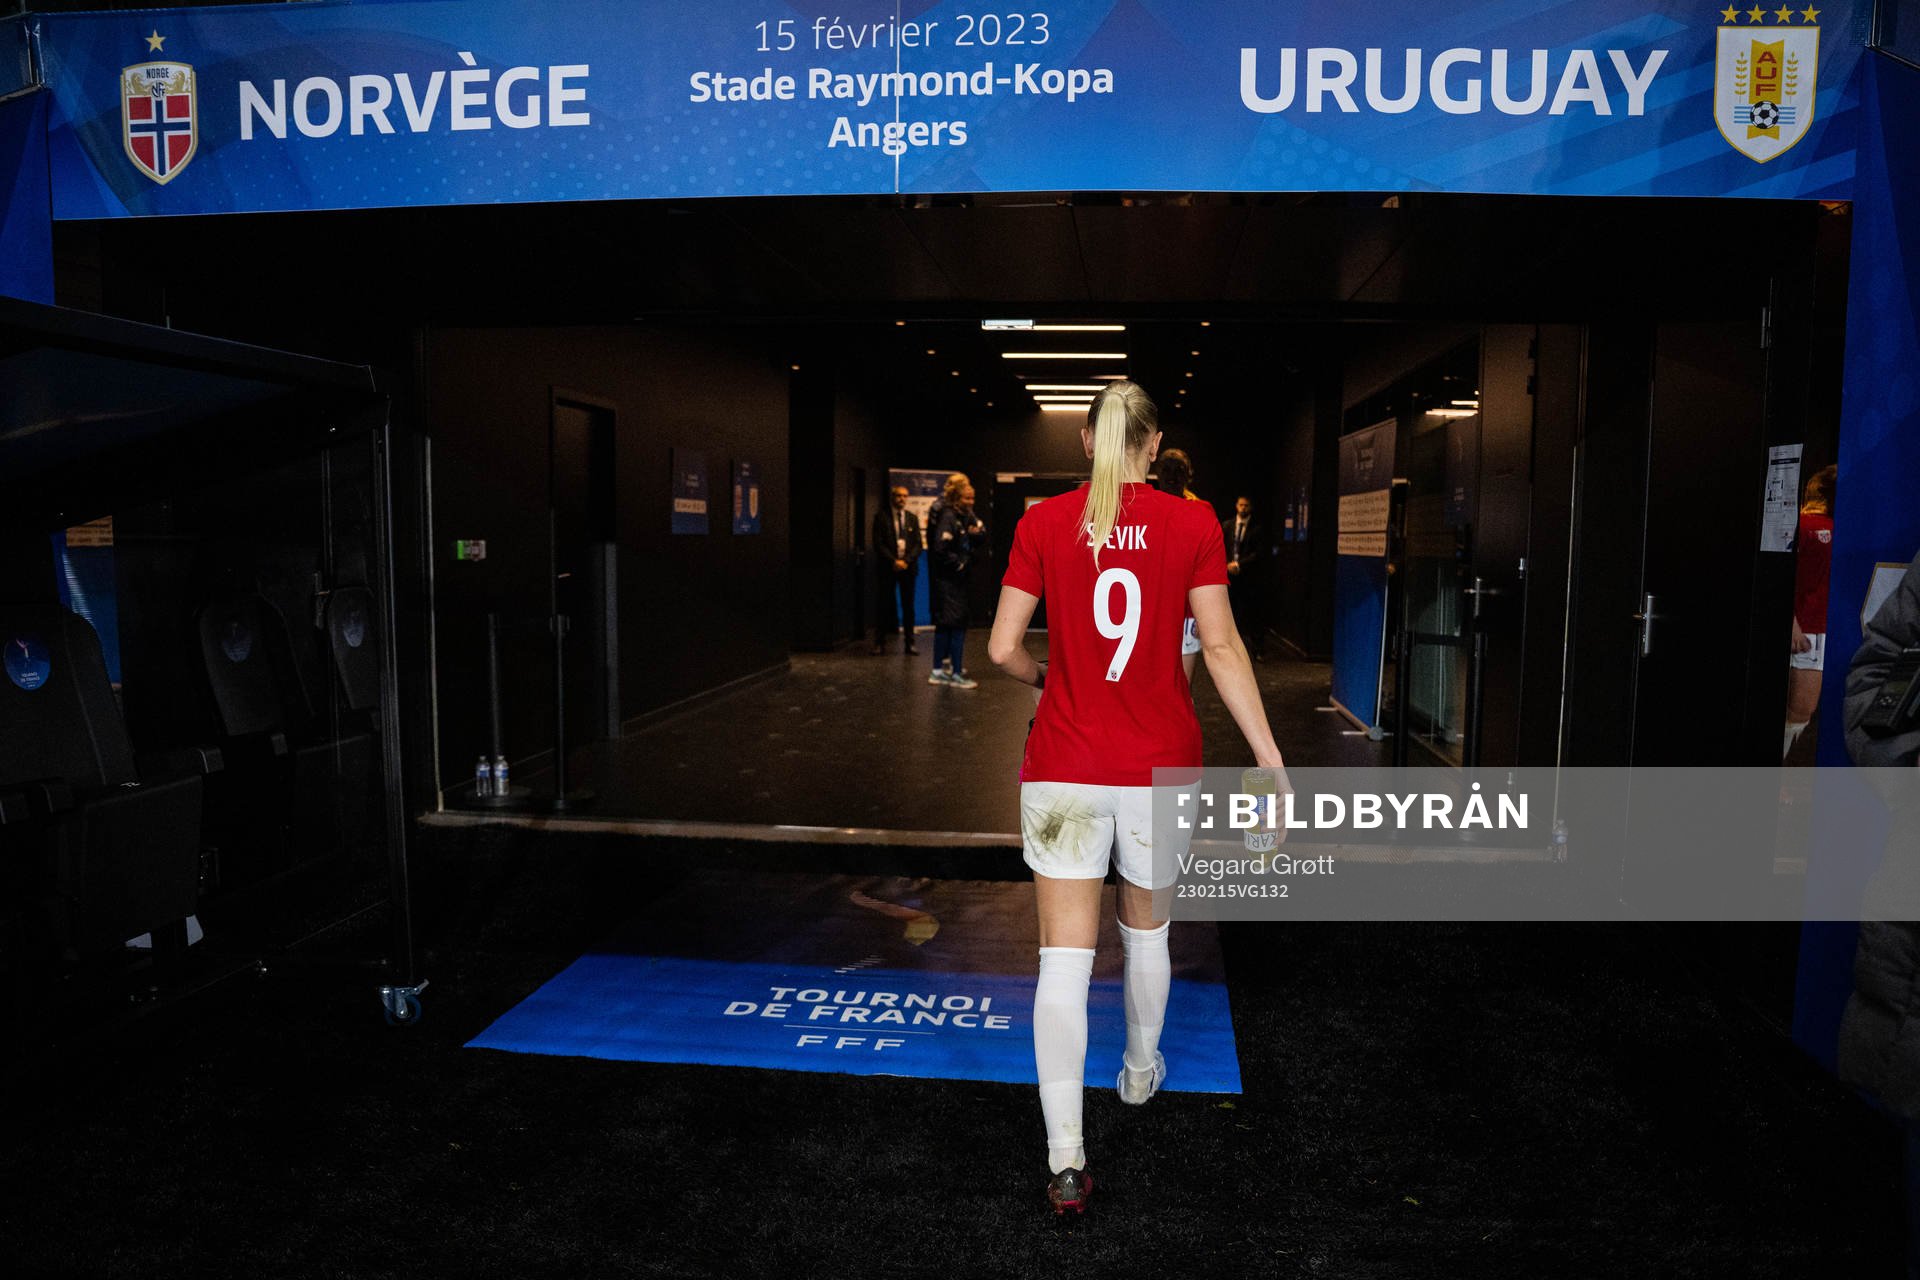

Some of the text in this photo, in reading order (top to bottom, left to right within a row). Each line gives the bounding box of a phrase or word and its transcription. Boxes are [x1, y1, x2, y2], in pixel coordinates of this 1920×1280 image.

[755, 13, 1051, 52] 15 février 2023
[147, 67, 169, 79] NORGE
[689, 62, 1115, 106] Stade Raymond-Kopa
[1238, 47, 1669, 117] URUGUAY
[238, 51, 591, 141] NORVÈGE
[828, 115, 968, 156] Angers
[1092, 567, 1142, 682] 9
[723, 1001, 1012, 1030] DE FRANCE
[770, 986, 993, 1013] TOURNOI
